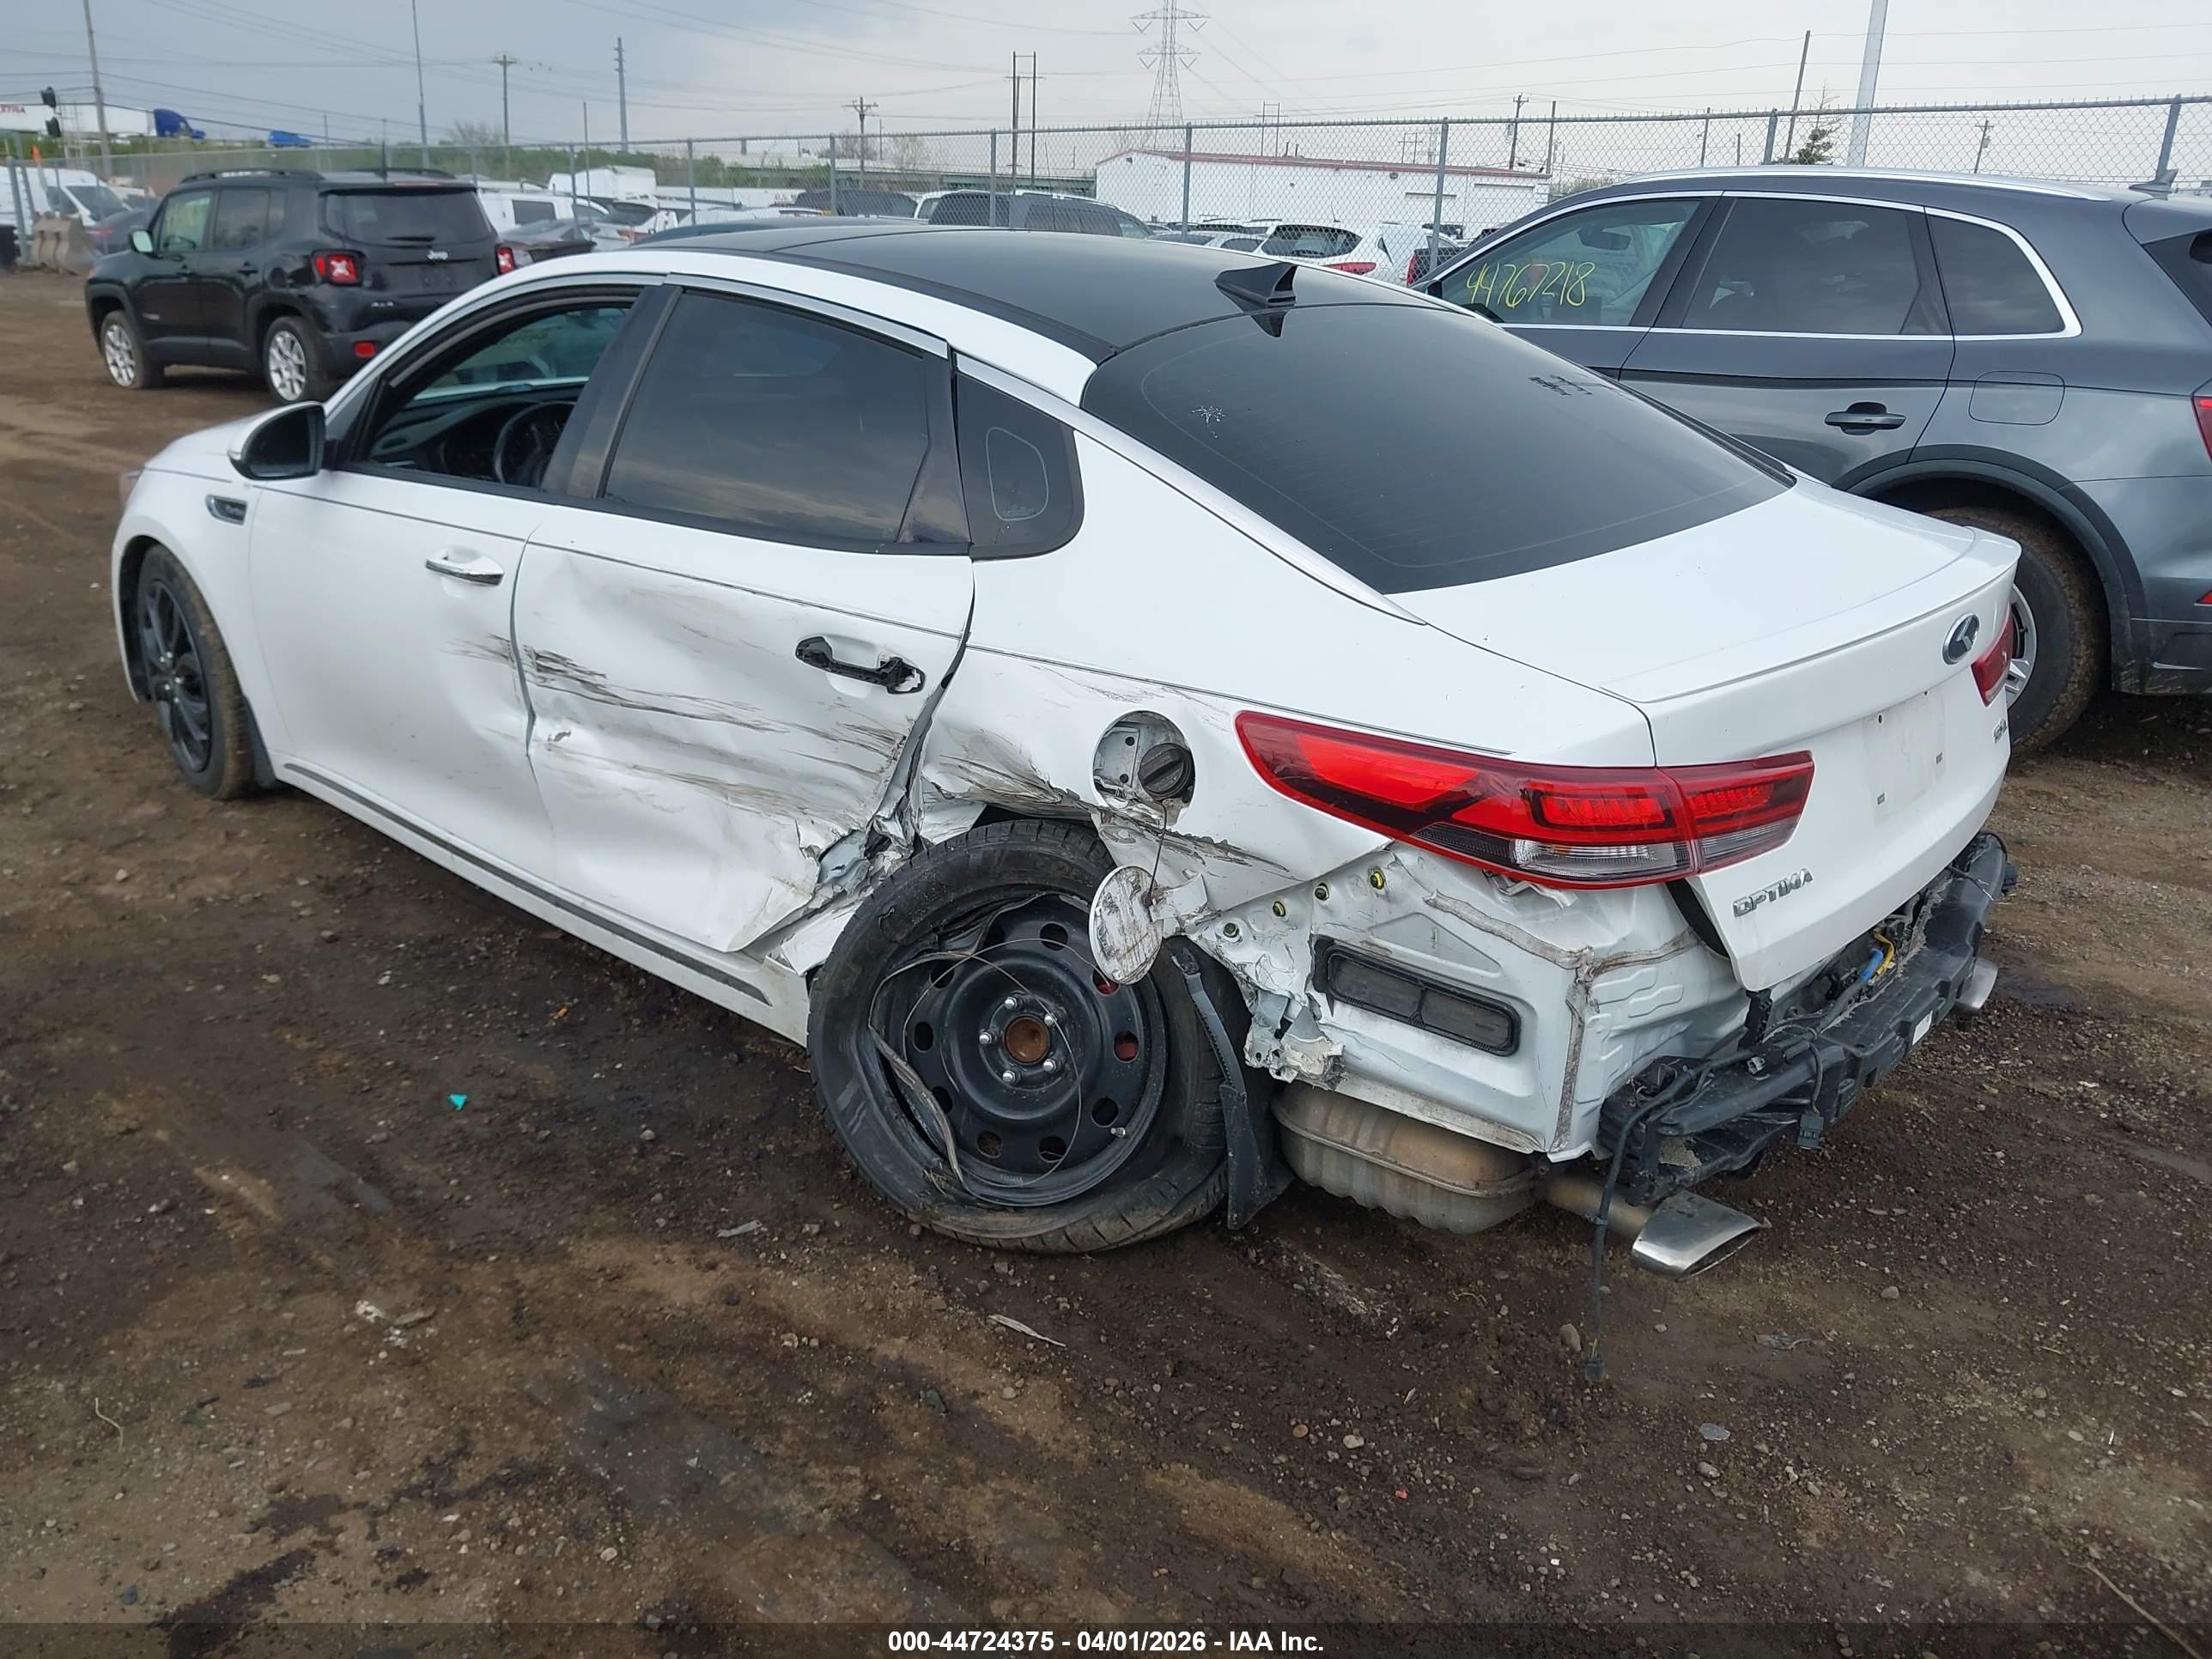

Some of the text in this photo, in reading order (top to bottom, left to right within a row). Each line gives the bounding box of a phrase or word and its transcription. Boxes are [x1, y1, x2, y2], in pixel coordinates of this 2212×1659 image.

[426, 249, 449, 260] Jeep
[1466, 260, 1596, 310] 44767218
[1732, 867, 1814, 918] OPTIMA
